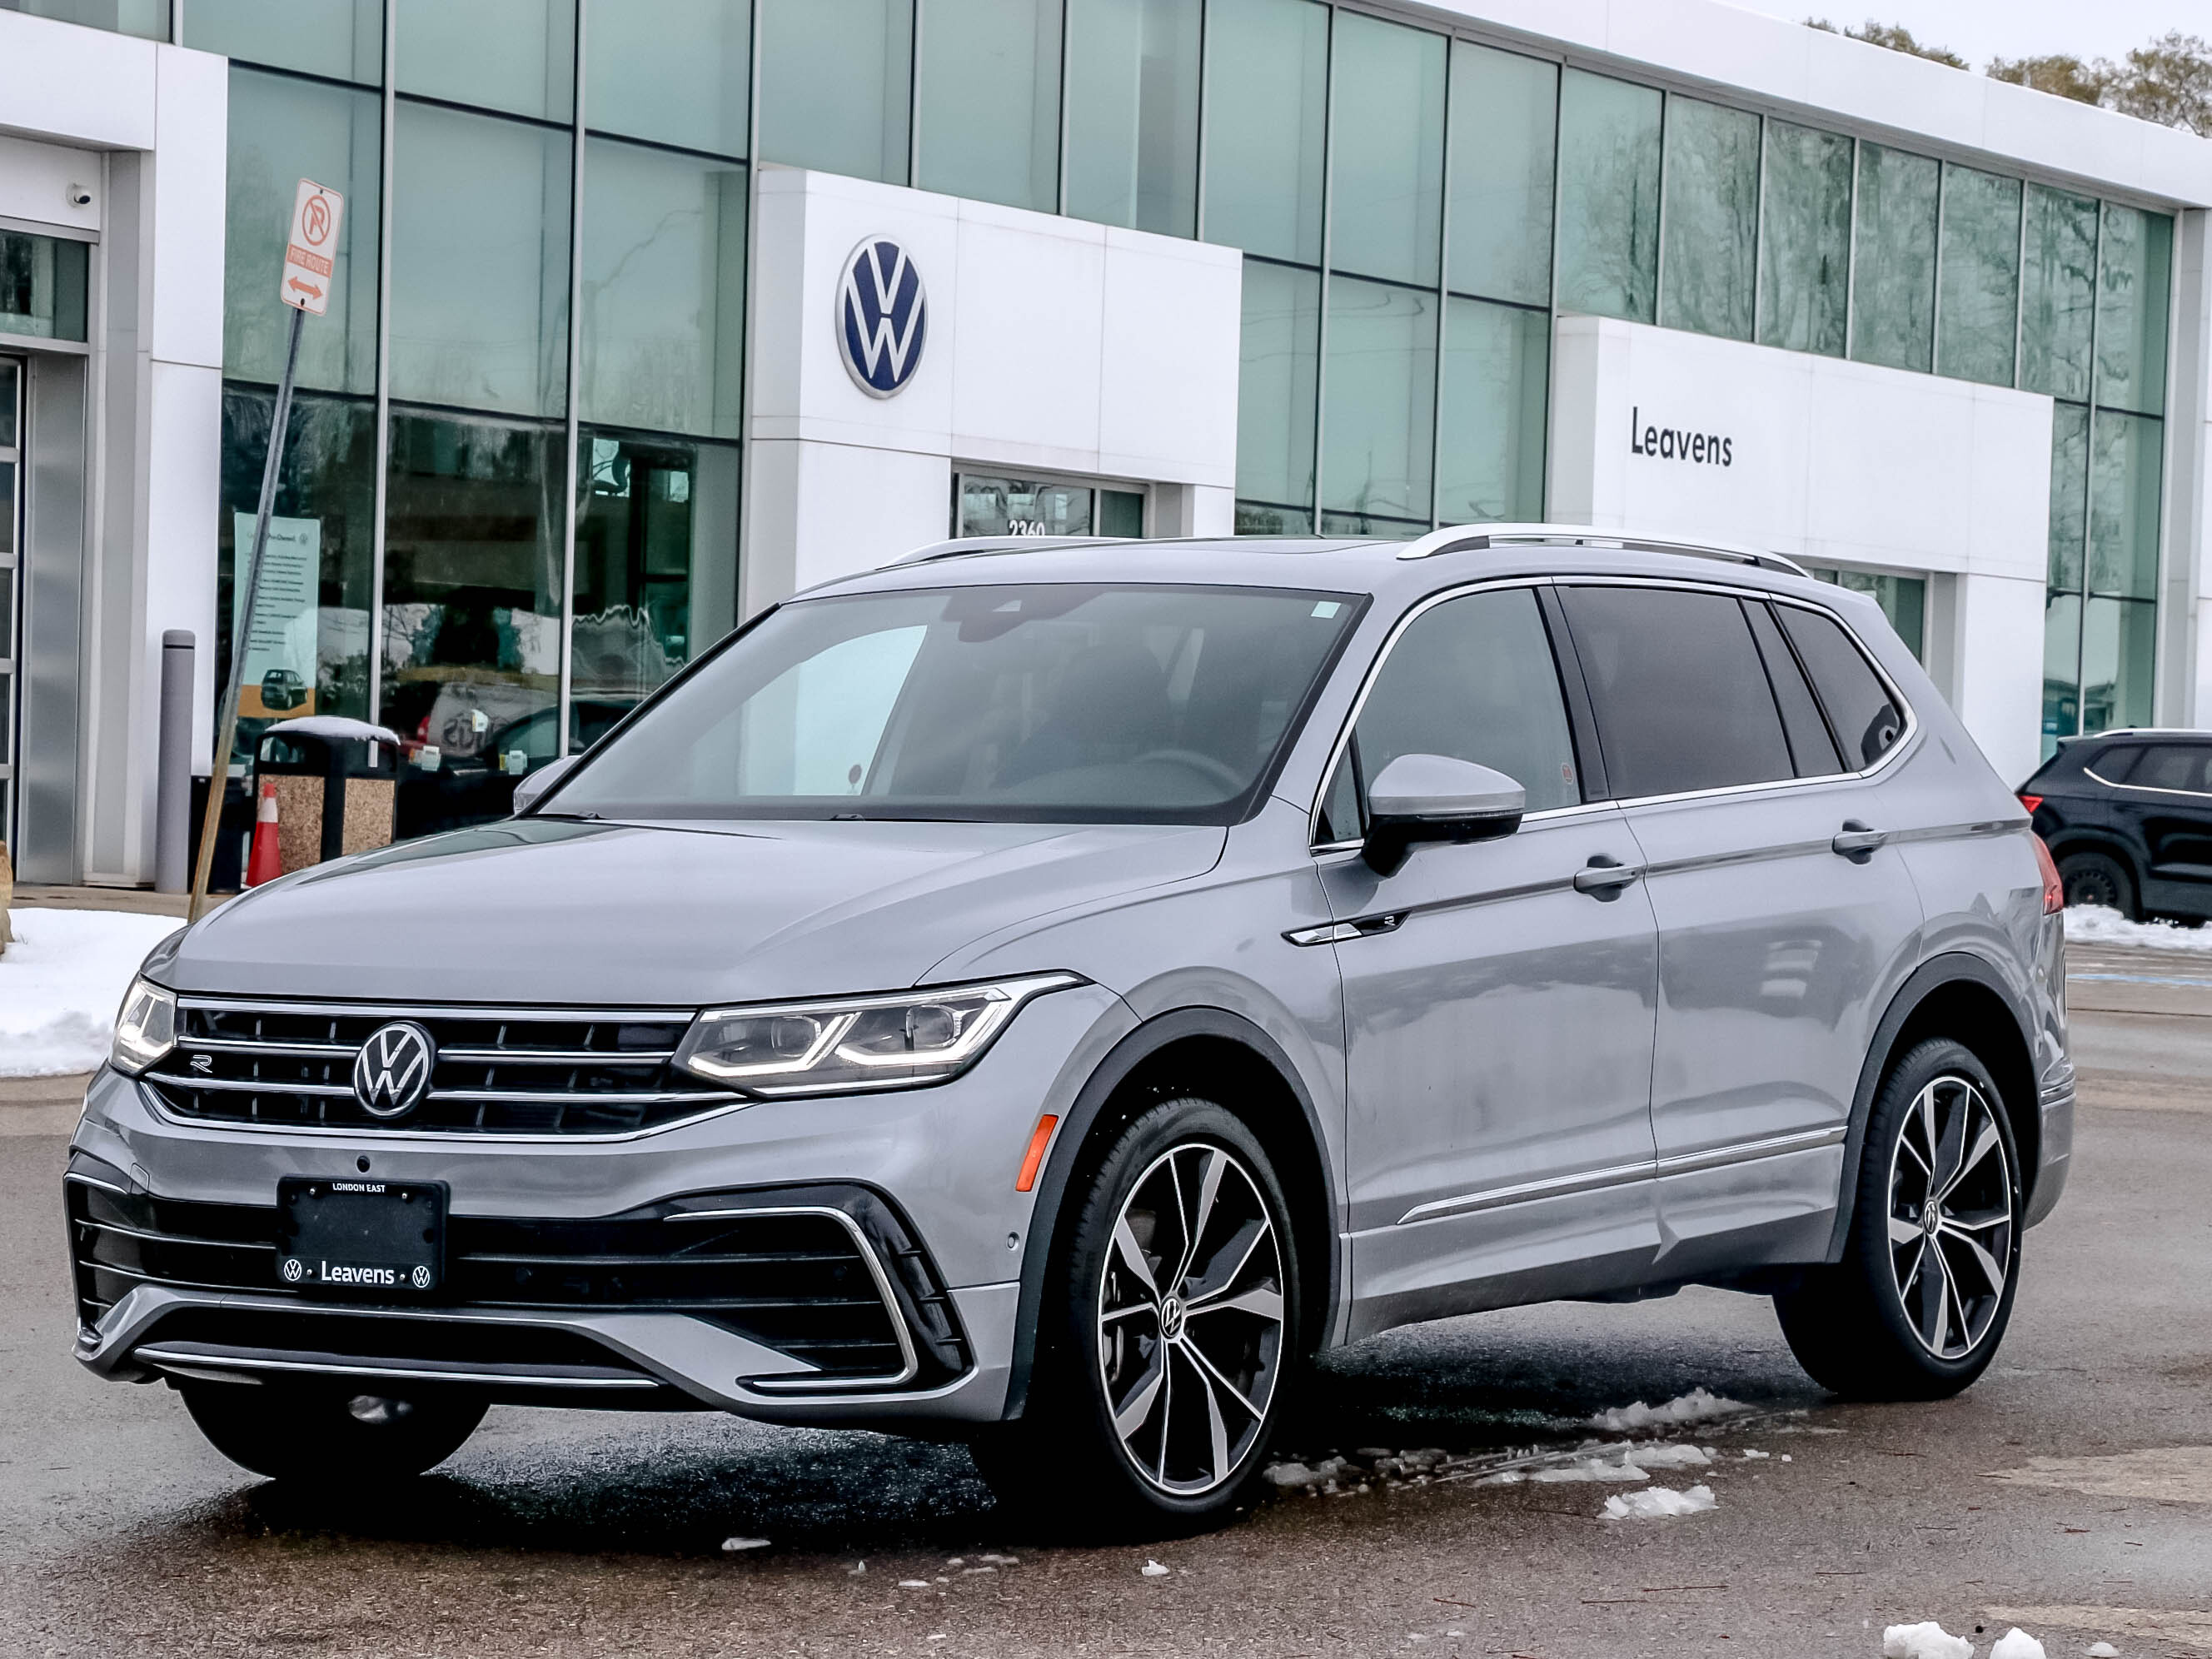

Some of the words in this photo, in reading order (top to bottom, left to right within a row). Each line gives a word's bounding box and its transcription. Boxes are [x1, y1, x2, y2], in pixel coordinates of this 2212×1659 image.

[290, 247, 306, 267] FIRE
[305, 252, 330, 275] ROUTE
[1632, 406, 1732, 467] Leavens
[1009, 519, 1045, 536] 2360
[332, 1183, 366, 1193] LONDON
[366, 1184, 386, 1193] EAST
[321, 1260, 395, 1285] Leavens
